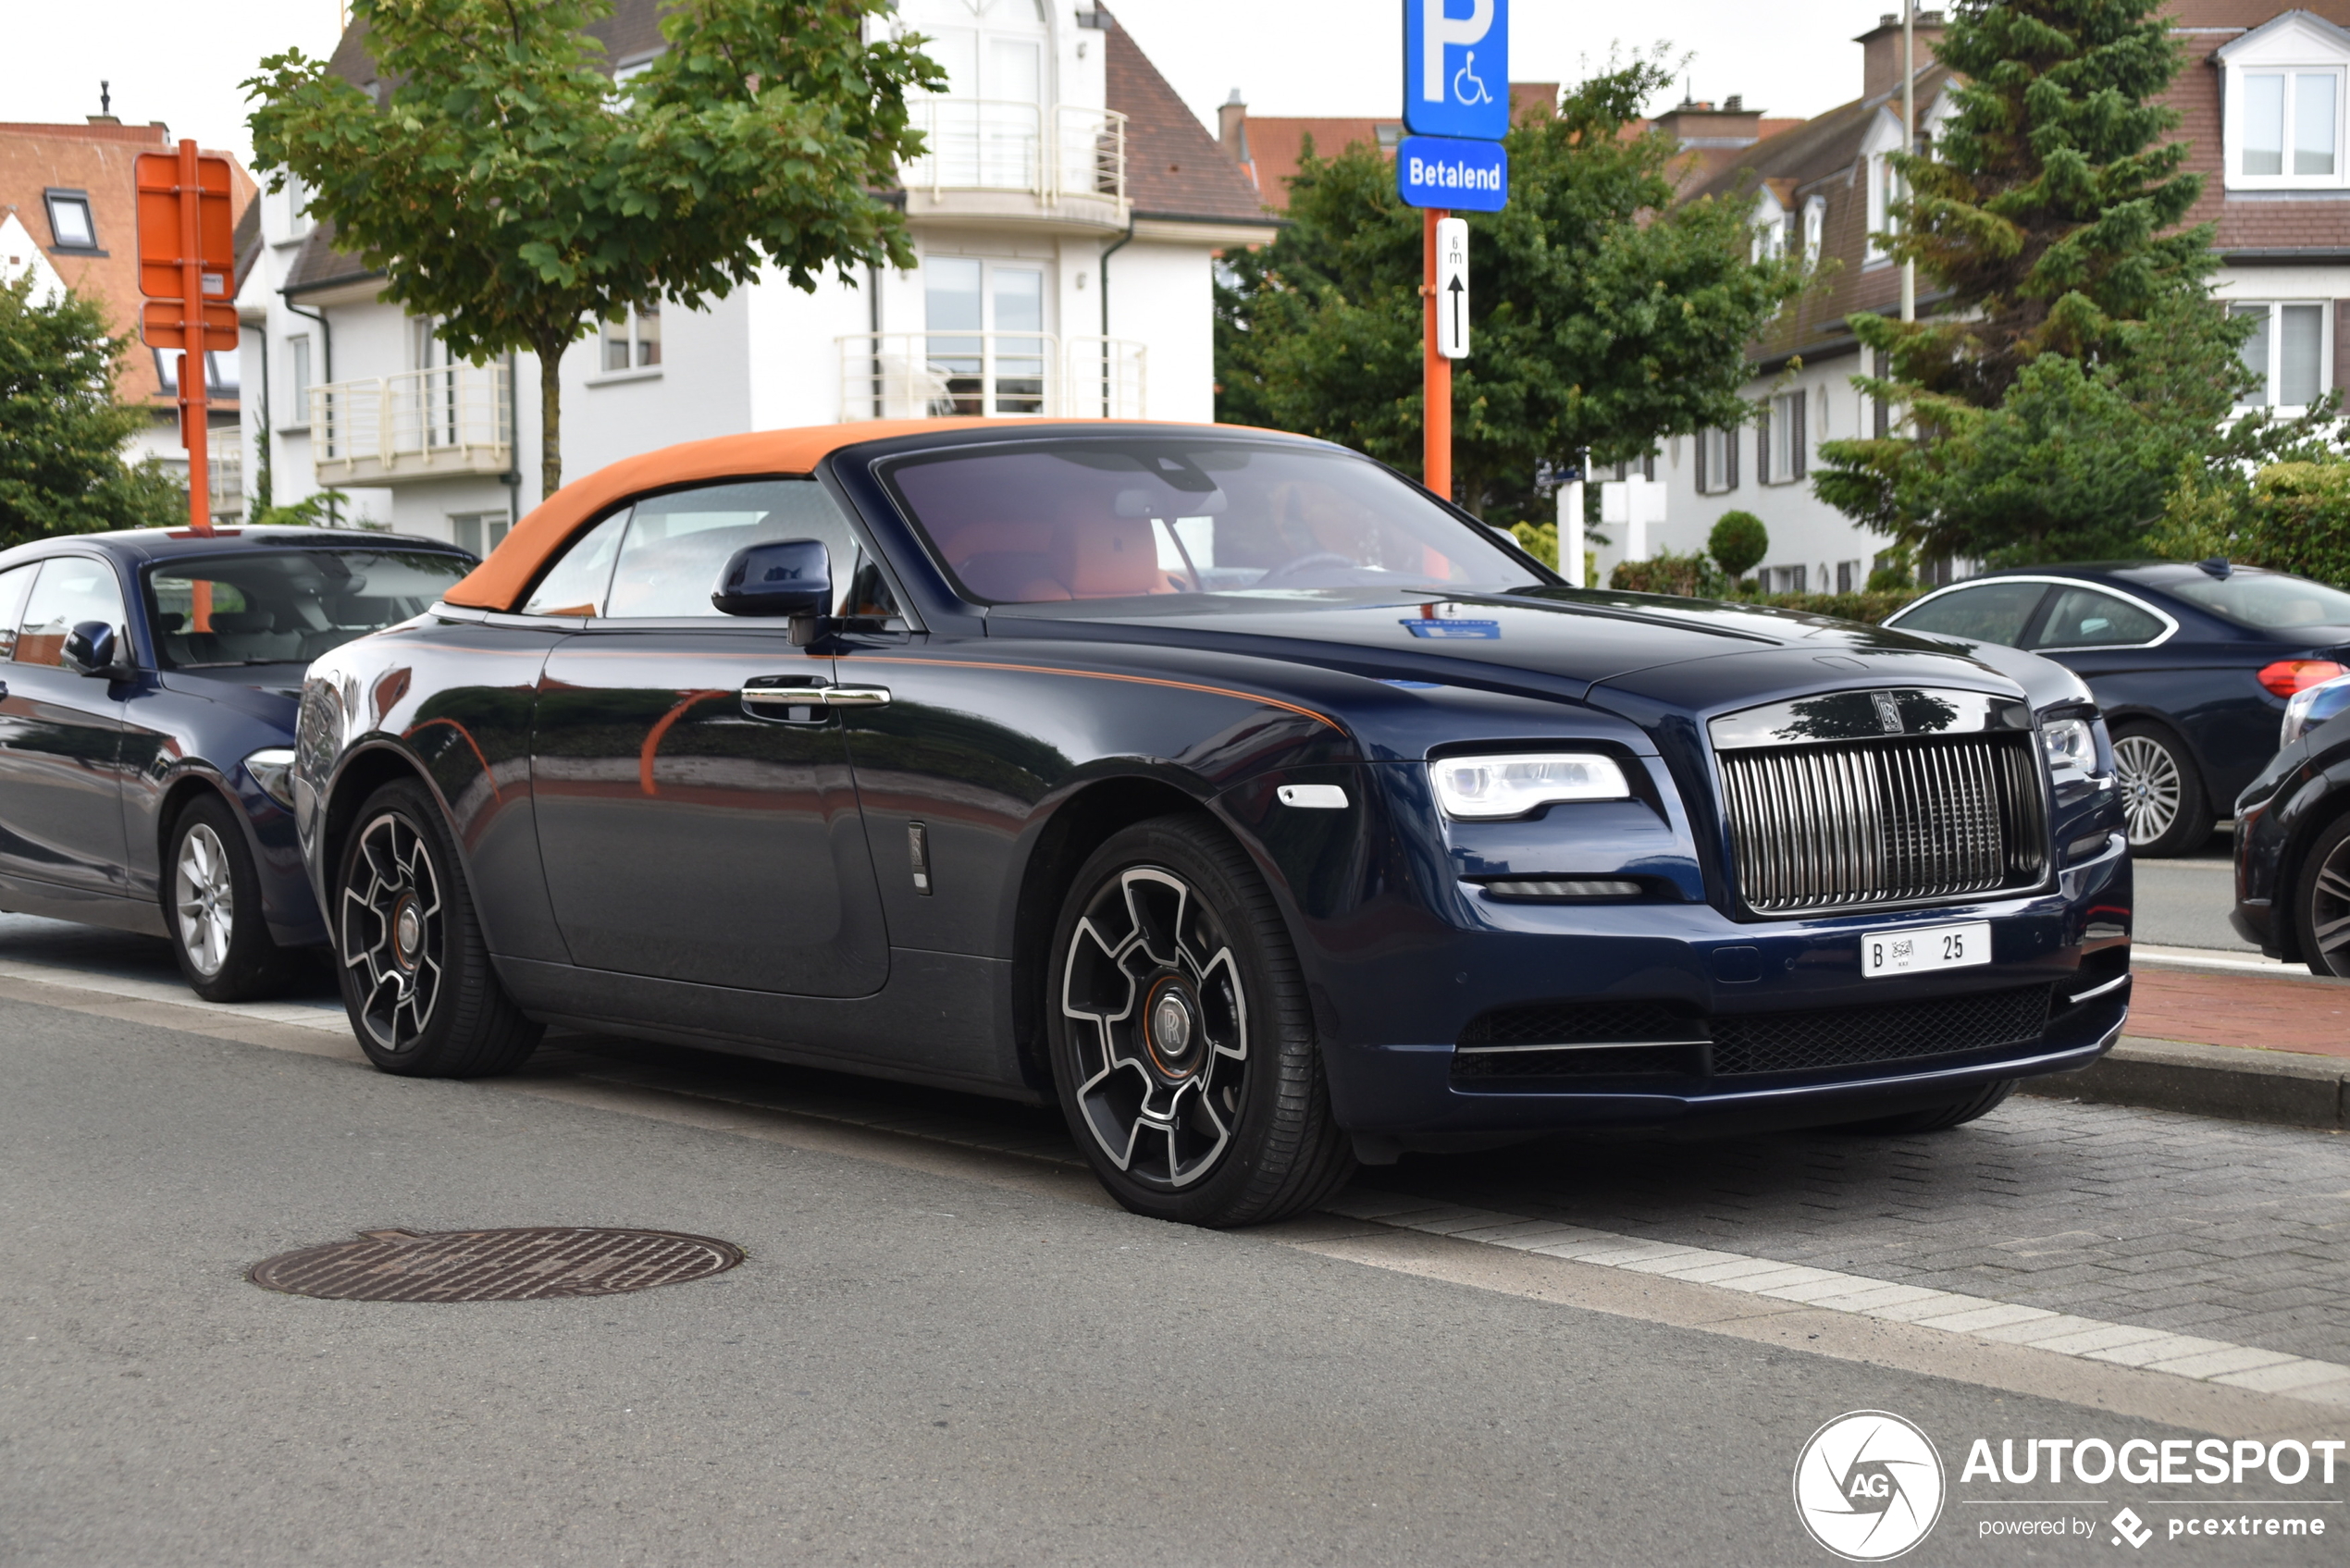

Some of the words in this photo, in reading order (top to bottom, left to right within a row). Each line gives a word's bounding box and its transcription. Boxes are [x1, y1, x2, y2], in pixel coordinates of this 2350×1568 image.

[1424, 0, 1494, 103] P
[1410, 157, 1501, 191] Betalend
[1450, 252, 1462, 265] m
[1452, 236, 1458, 250] 6
[1874, 943, 1883, 969] B
[1944, 933, 1963, 960] 25
